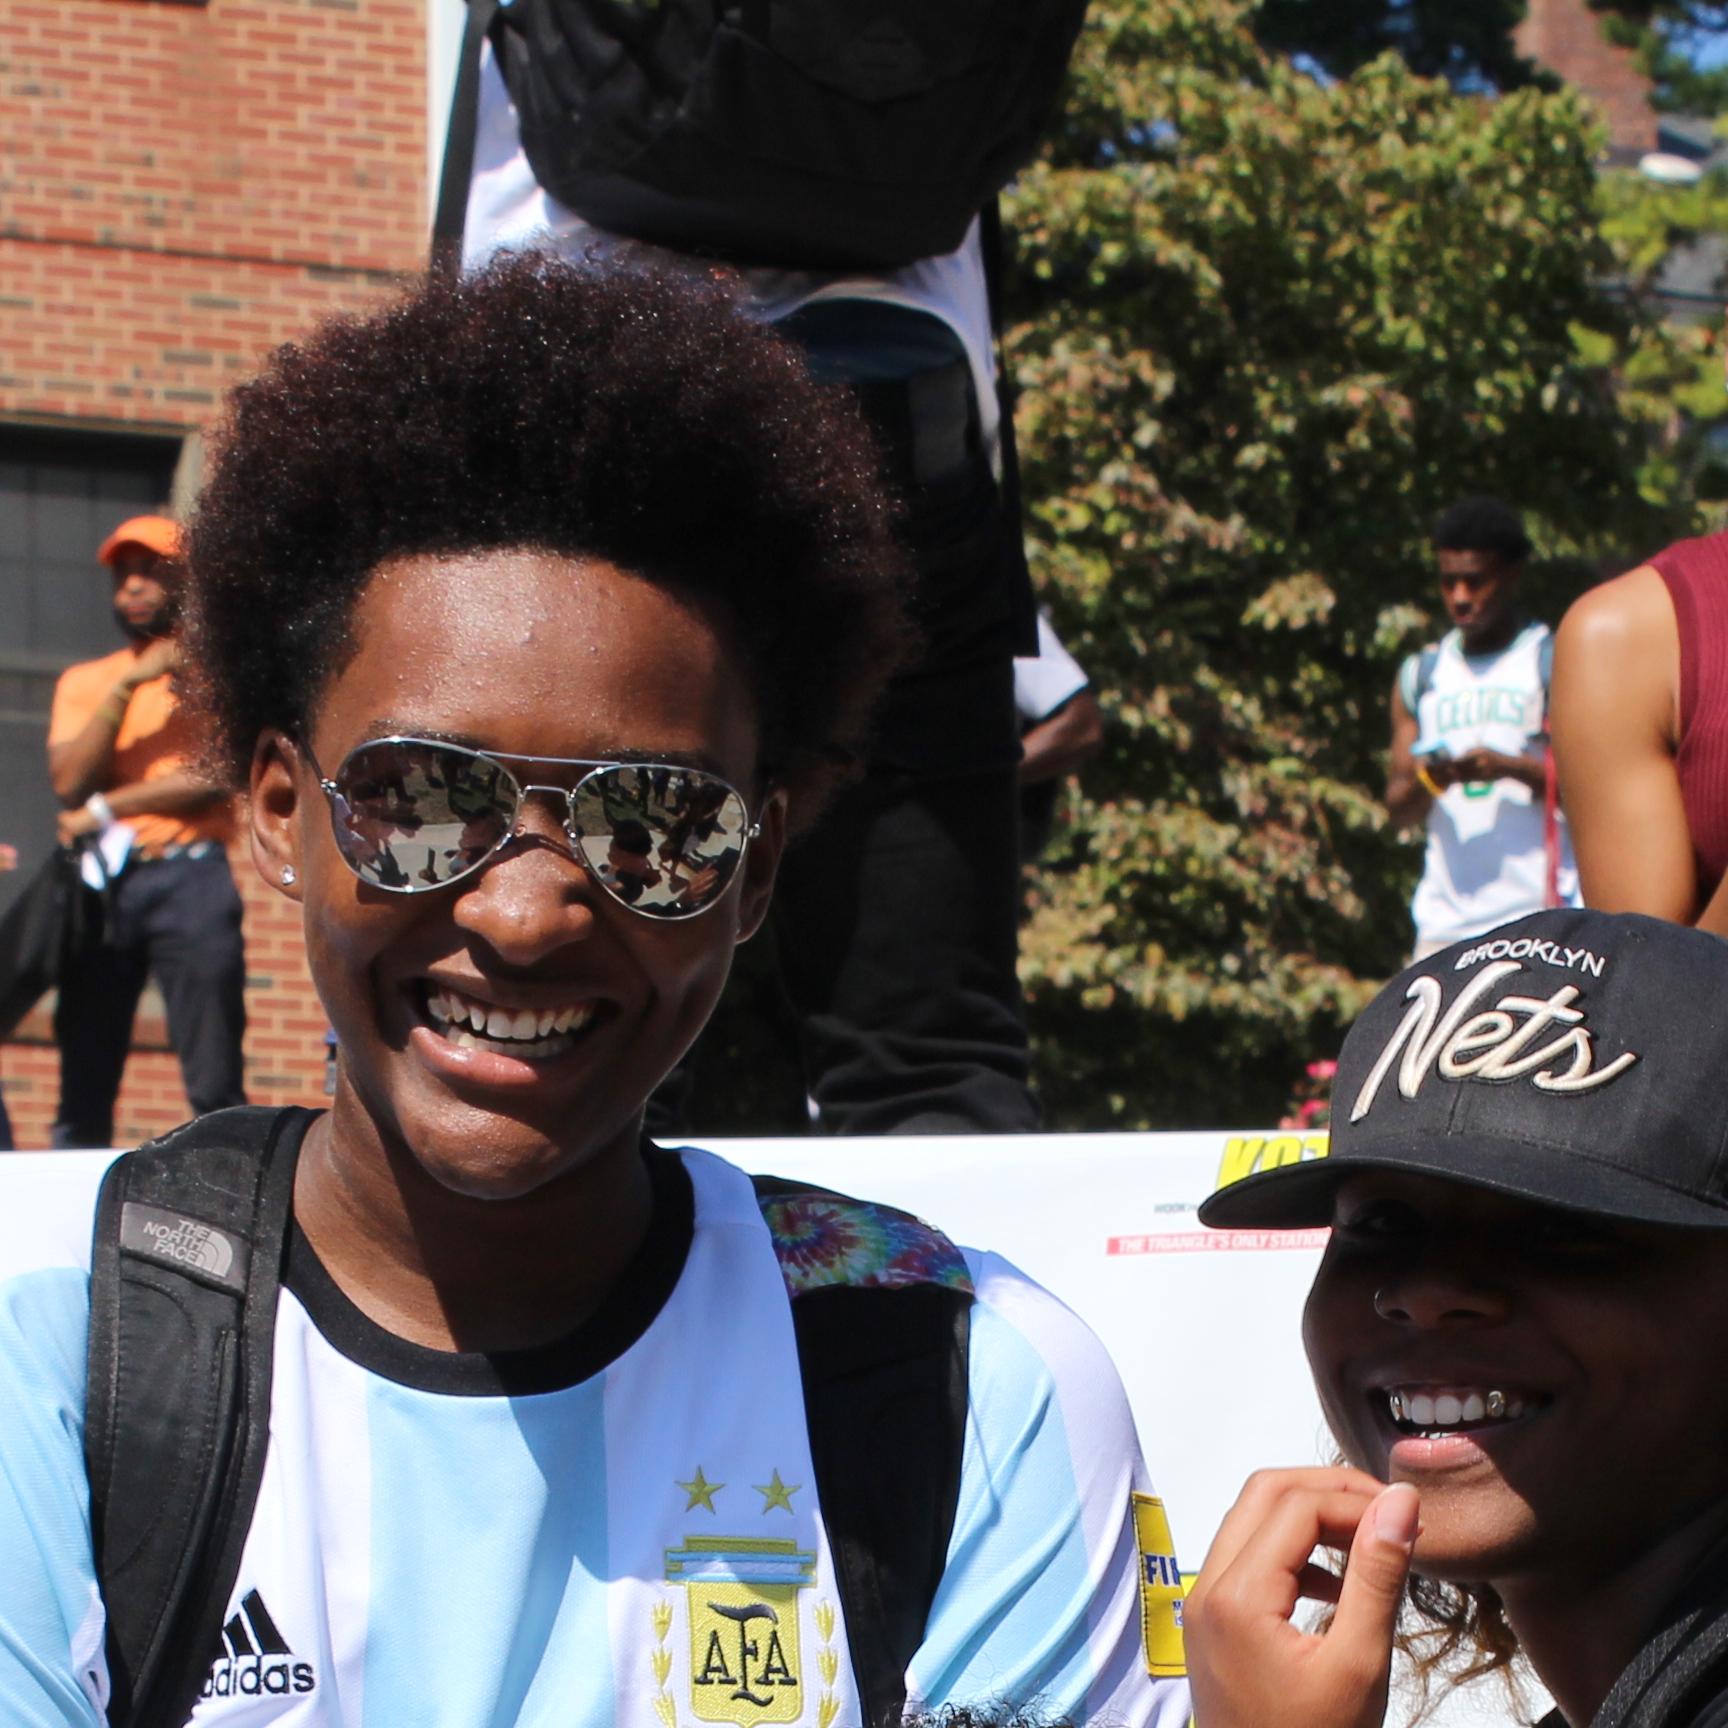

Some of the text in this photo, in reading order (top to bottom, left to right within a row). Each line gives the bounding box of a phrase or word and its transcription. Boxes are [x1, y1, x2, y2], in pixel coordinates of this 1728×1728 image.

[1454, 934, 1606, 979] BROOKLYN
[1350, 960, 1637, 1124] Nets
[142, 1221, 206, 1252] NORTH
[177, 1219, 211, 1240] THE
[152, 1239, 201, 1264] FACE
